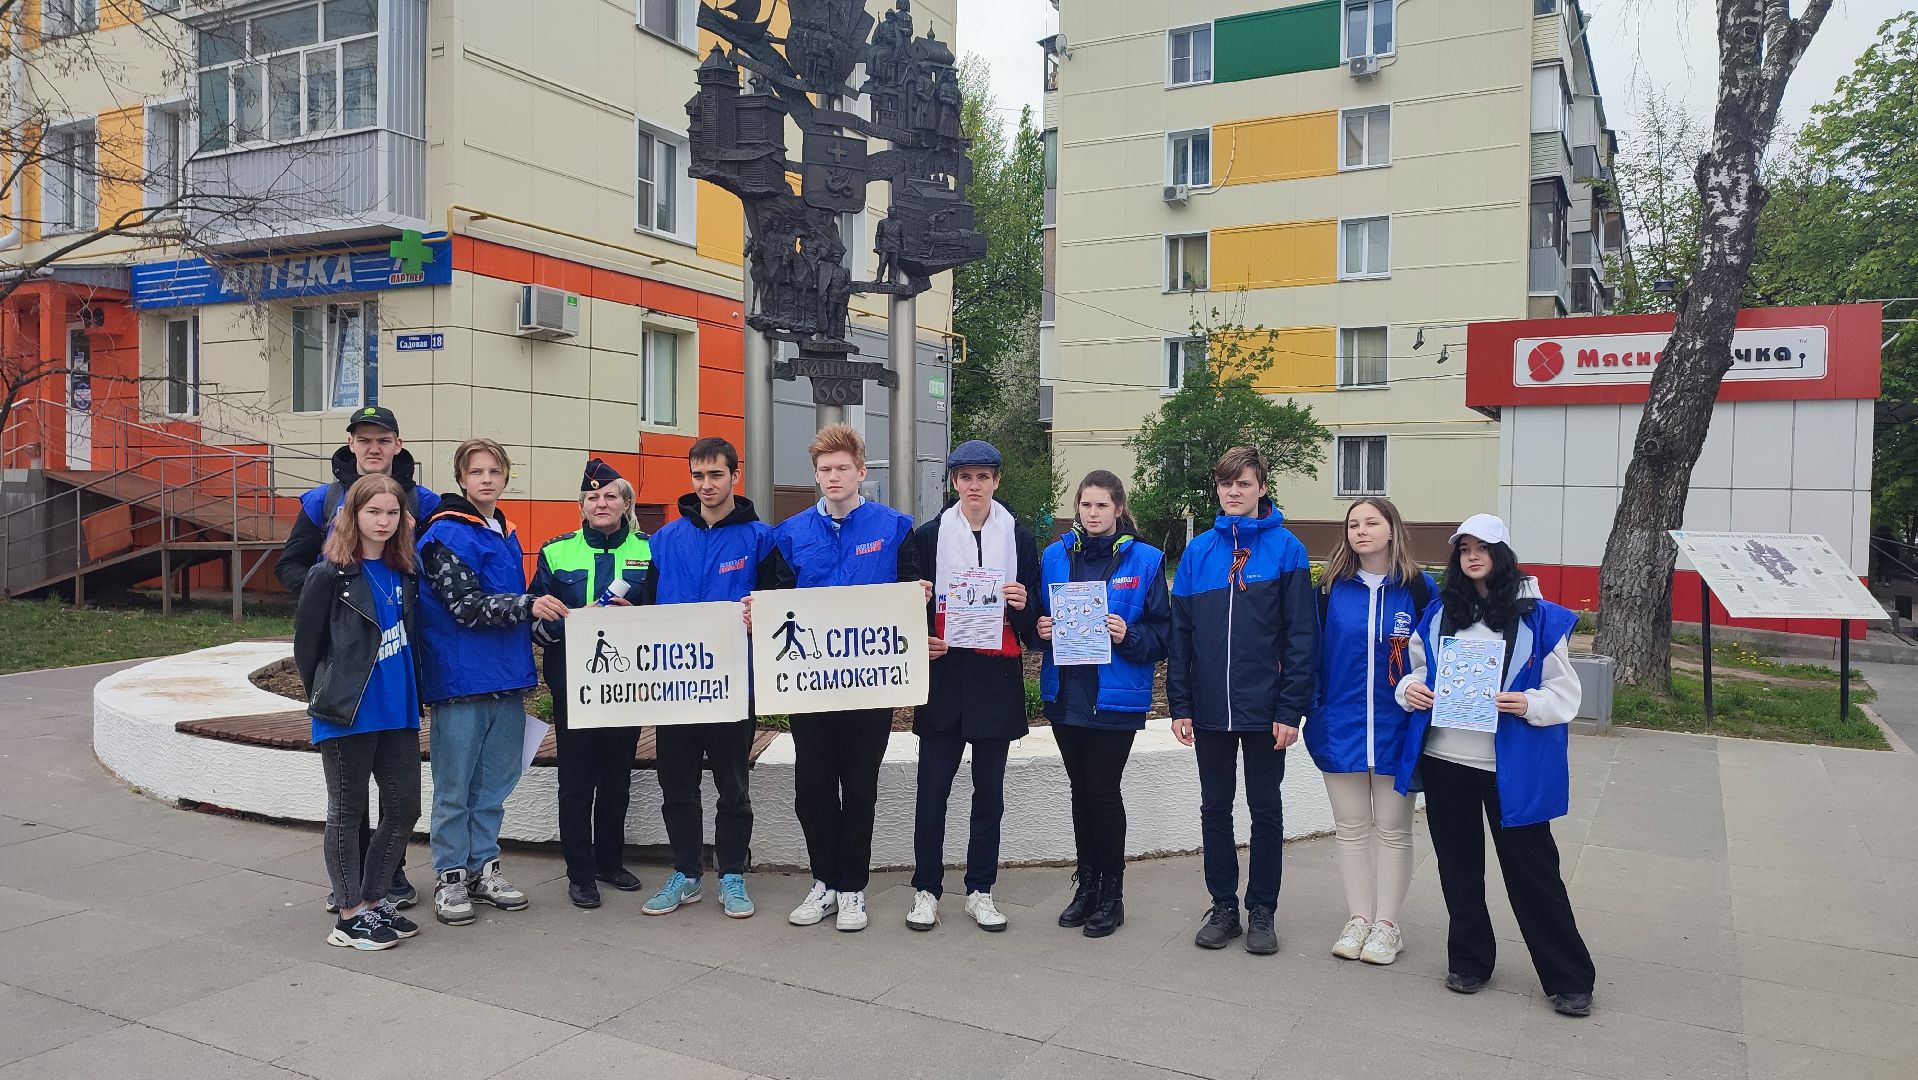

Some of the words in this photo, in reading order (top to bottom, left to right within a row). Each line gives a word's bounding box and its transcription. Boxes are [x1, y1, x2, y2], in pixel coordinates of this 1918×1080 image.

[219, 251, 353, 295] АПТЕКА
[390, 269, 424, 284] ПАРТНЕР
[399, 340, 428, 350] Садовая
[432, 335, 443, 348] 18
[796, 361, 878, 379] КАШИРА
[815, 378, 863, 403] 665
[826, 625, 909, 658] слезь
[636, 642, 714, 672] слезь
[579, 684, 592, 705] с
[600, 674, 730, 705] велосипеда!
[776, 672, 789, 693] с
[796, 661, 910, 692] самоката!
